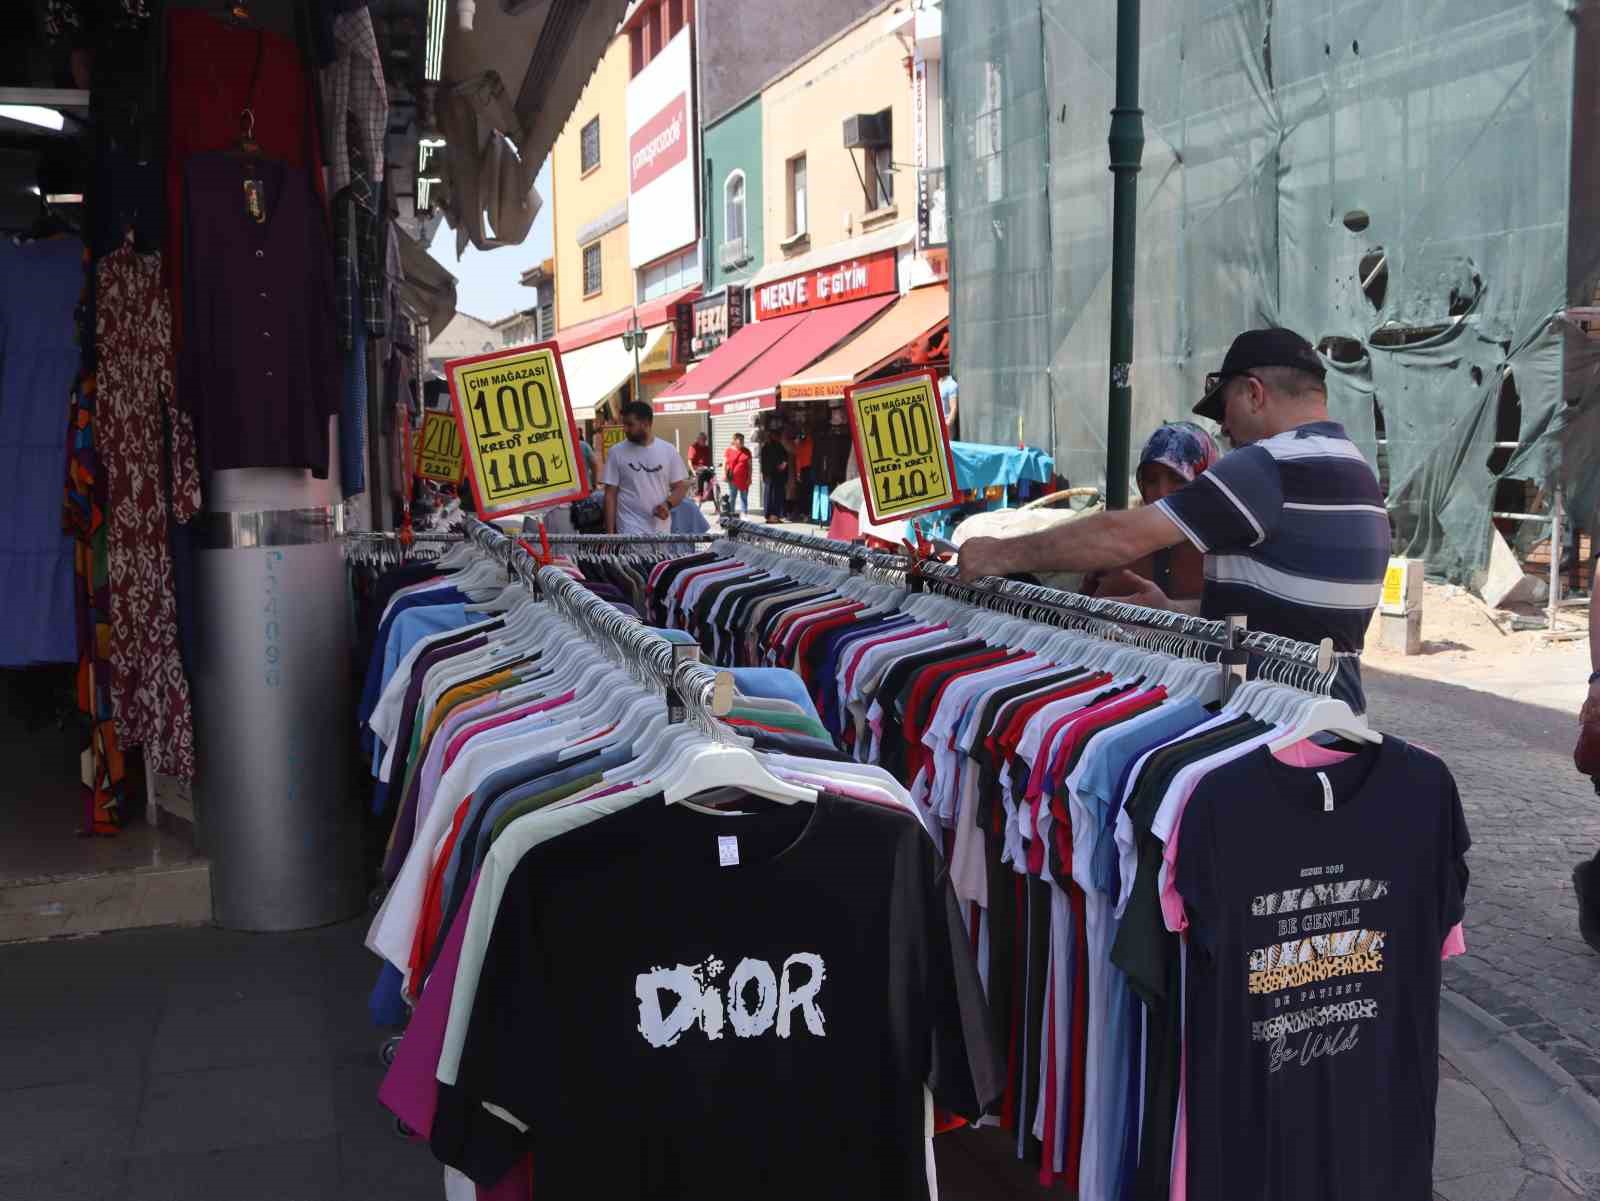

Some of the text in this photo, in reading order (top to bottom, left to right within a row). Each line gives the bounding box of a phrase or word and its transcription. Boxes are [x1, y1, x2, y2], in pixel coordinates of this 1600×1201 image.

[760, 277, 807, 311] MERVE
[832, 262, 868, 294] GİYİM
[469, 366, 545, 391] ÇİM MAĞAZASI
[473, 381, 553, 438] 100
[864, 394, 926, 416] ÇİM MAĞAZASI
[869, 403, 933, 463] 100
[489, 451, 549, 492] 110
[881, 469, 928, 504] 110
[1278, 907, 1360, 936] BE GENTLE
